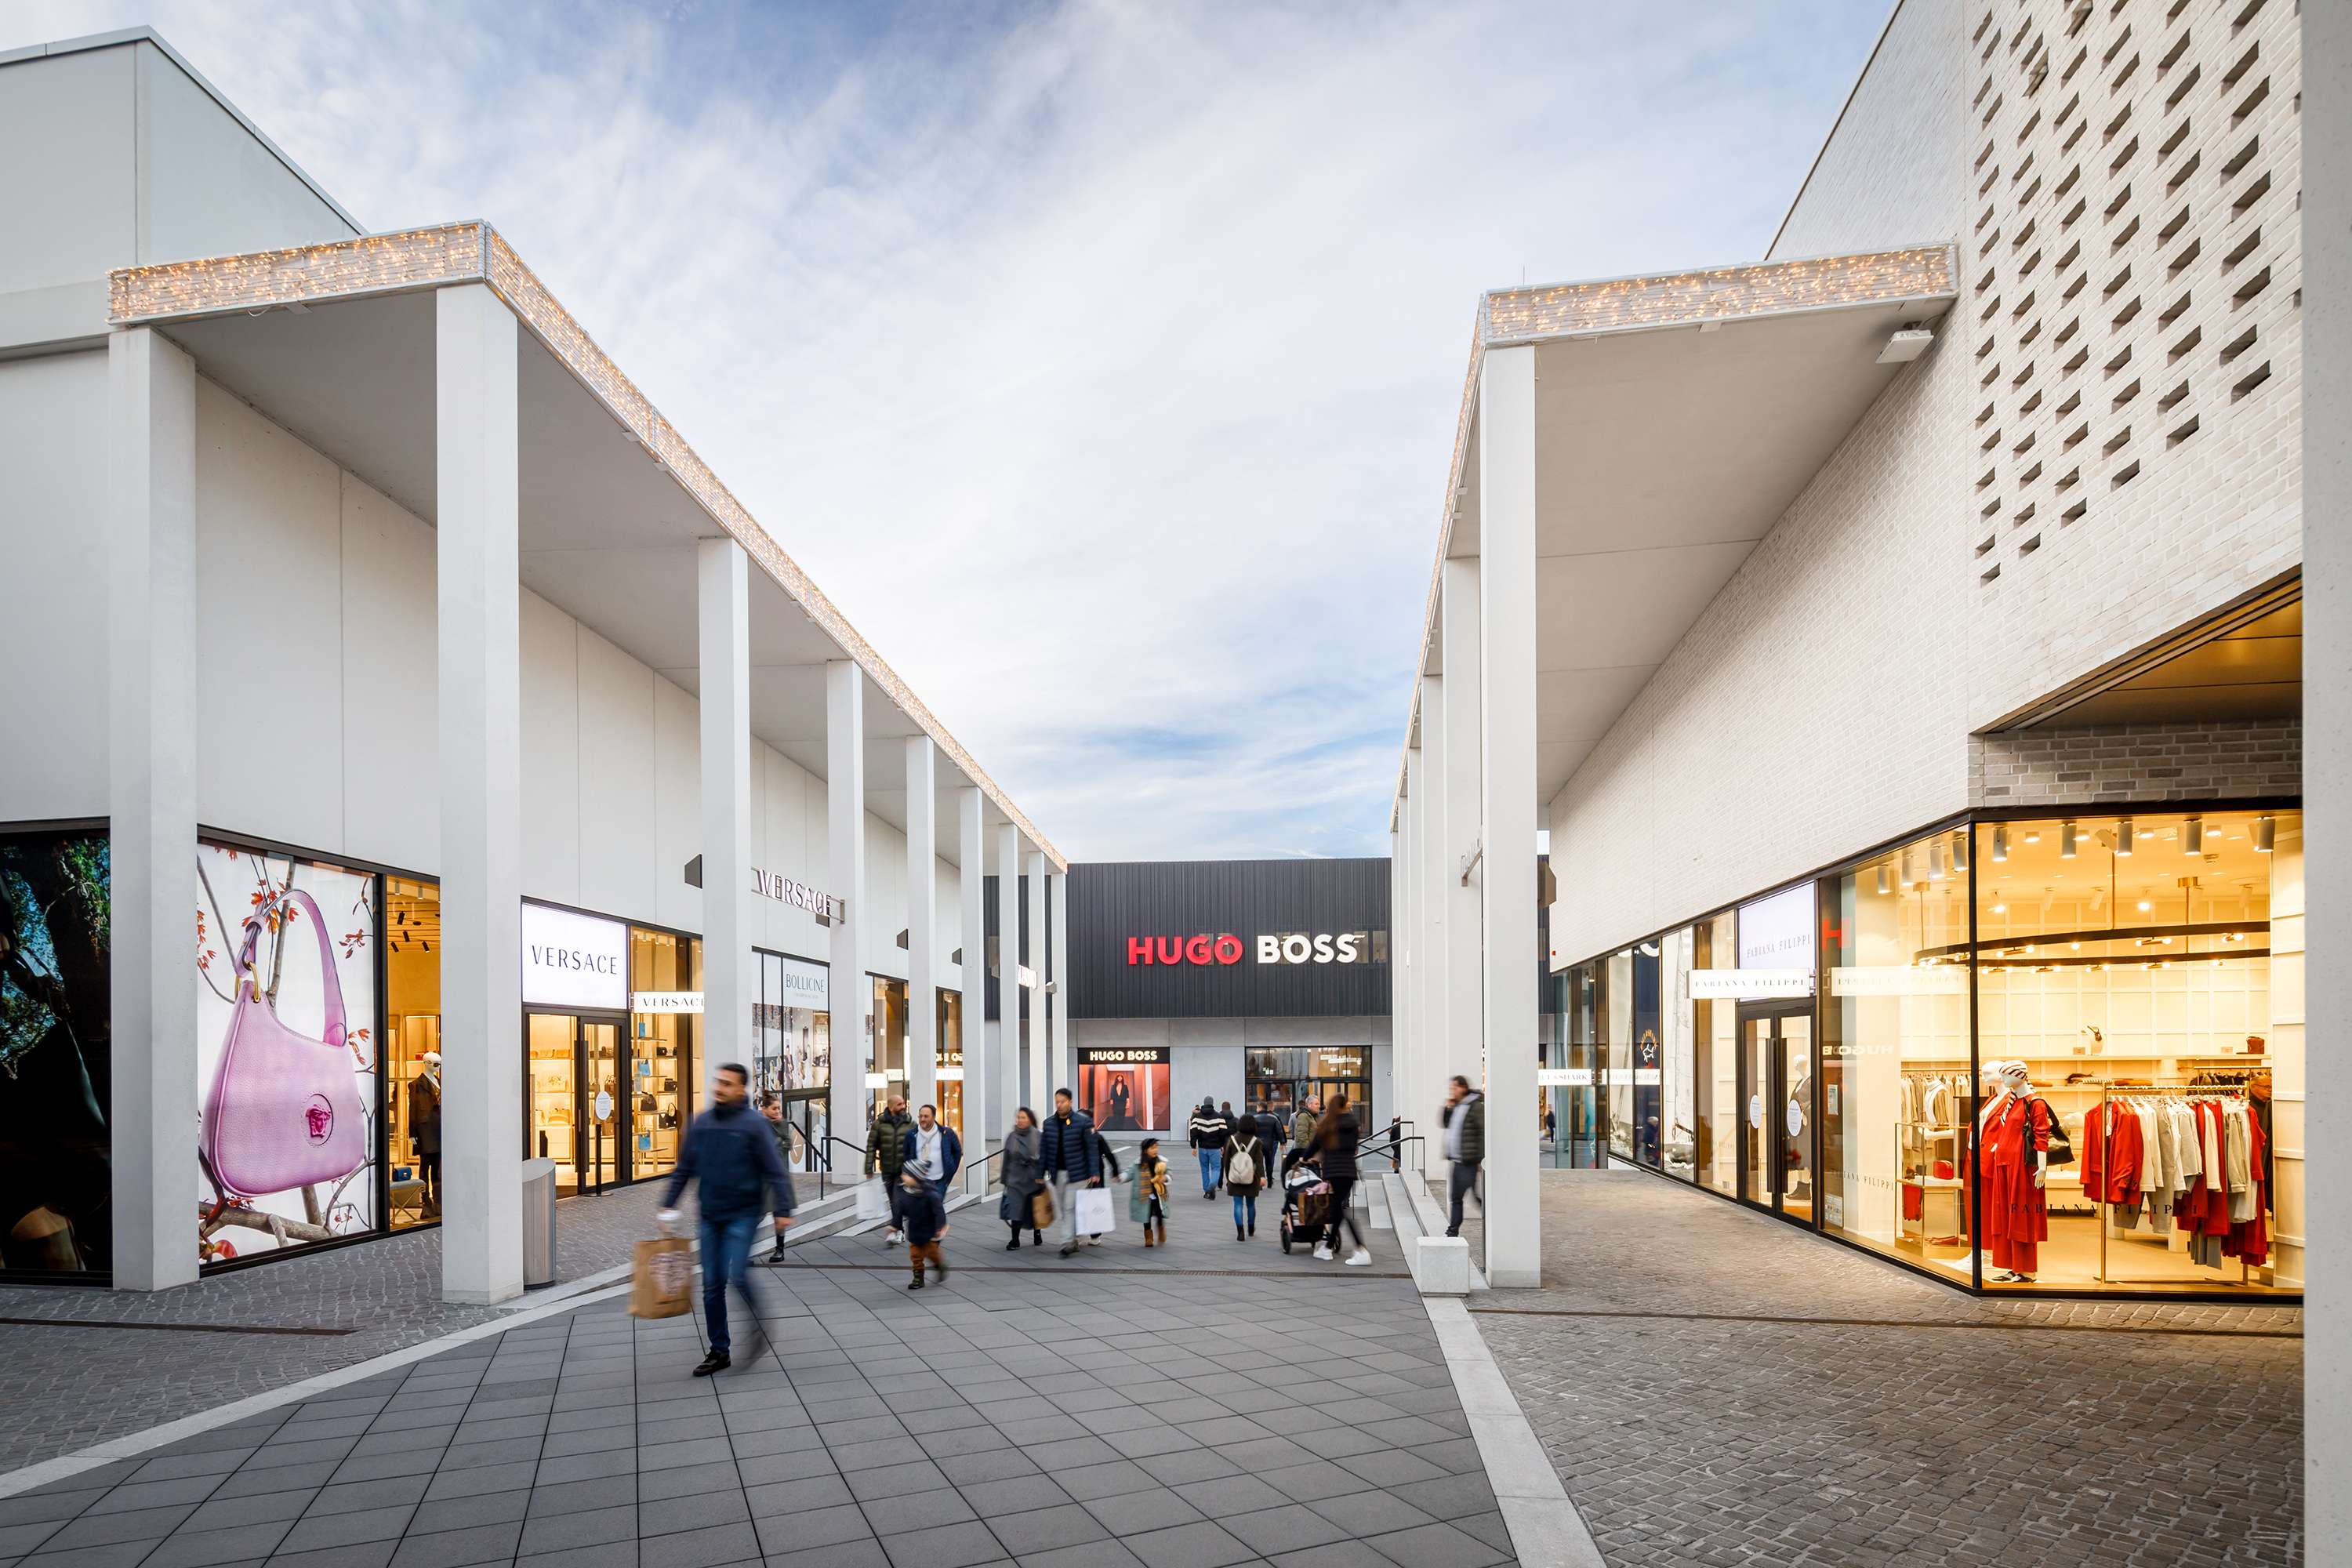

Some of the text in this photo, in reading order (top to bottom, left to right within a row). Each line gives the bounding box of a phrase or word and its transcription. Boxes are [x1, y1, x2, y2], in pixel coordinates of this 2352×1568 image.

[757, 869, 832, 916] VERSACE
[1127, 934, 1358, 965] HUGO BOSS
[1747, 944, 1775, 958] FABIANA
[1780, 934, 1810, 950] FILIPPI
[532, 945, 617, 975] VERSACE
[786, 973, 825, 993] BOLLICINE
[1089, 1051, 1157, 1061] HUGO BOSS
[1864, 1175, 1893, 1191] FILIPPI
[2010, 1203, 2097, 1214] FABIANA
